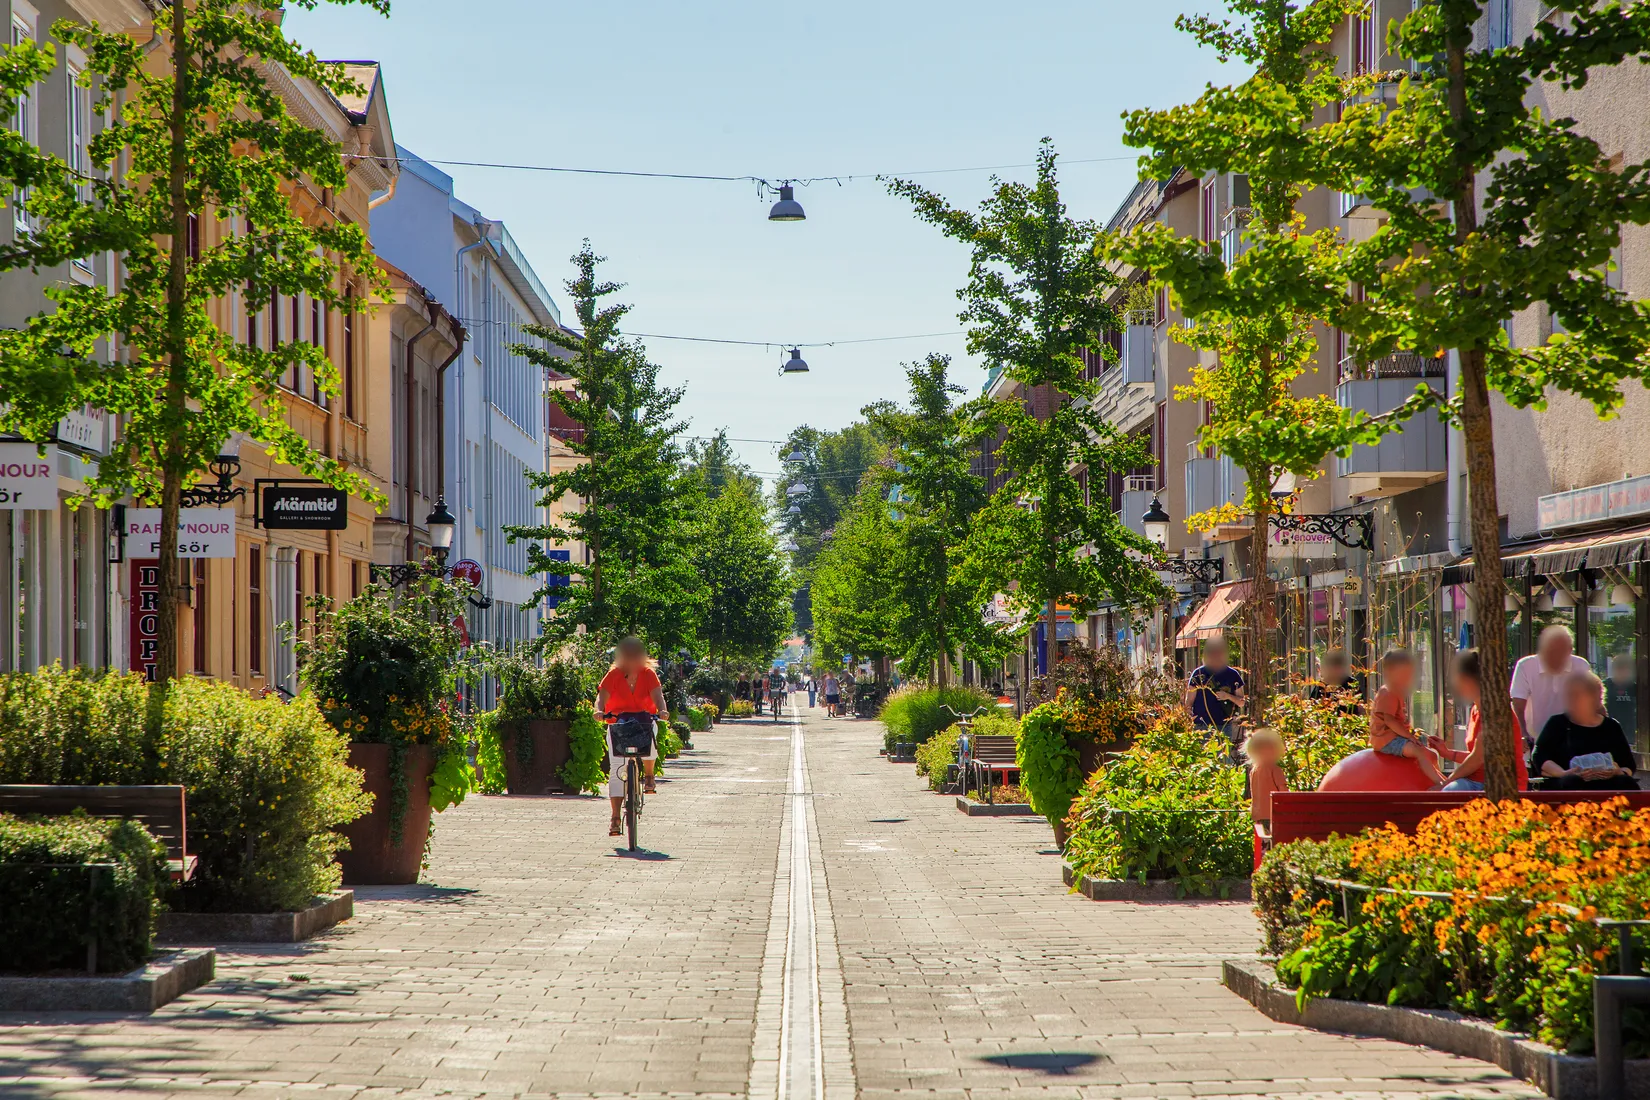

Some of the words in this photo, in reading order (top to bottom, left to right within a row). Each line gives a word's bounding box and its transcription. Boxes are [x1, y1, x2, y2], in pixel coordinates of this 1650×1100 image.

[273, 497, 337, 512] skärmtid
[187, 524, 230, 534] NOUR
[150, 542, 209, 553] Fsör
[1344, 582, 1357, 591] 25C
